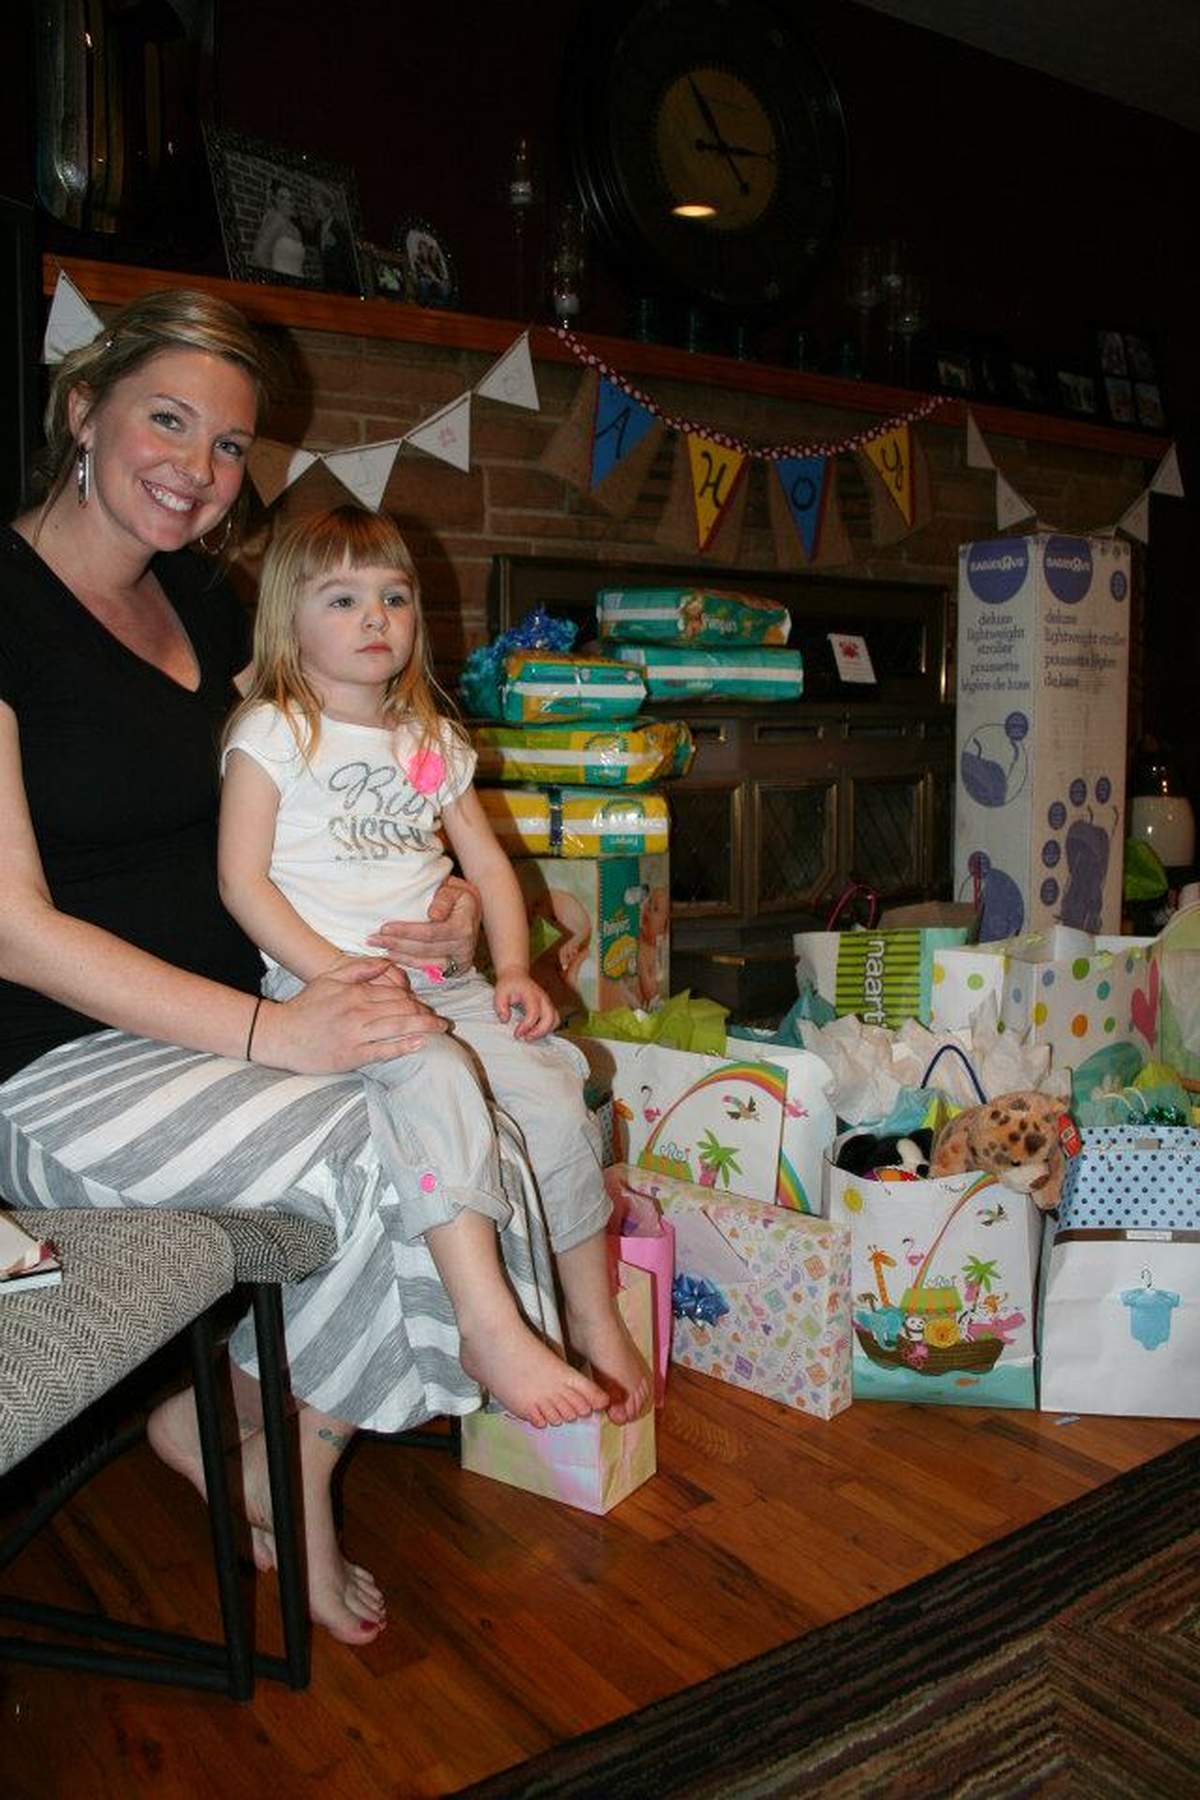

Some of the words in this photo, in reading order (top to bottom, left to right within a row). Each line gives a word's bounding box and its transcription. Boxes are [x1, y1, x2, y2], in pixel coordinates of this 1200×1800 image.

[595, 406, 633, 460] A
[698, 450, 726, 510] H
[789, 476, 818, 512] O
[863, 939, 888, 1028] naart
